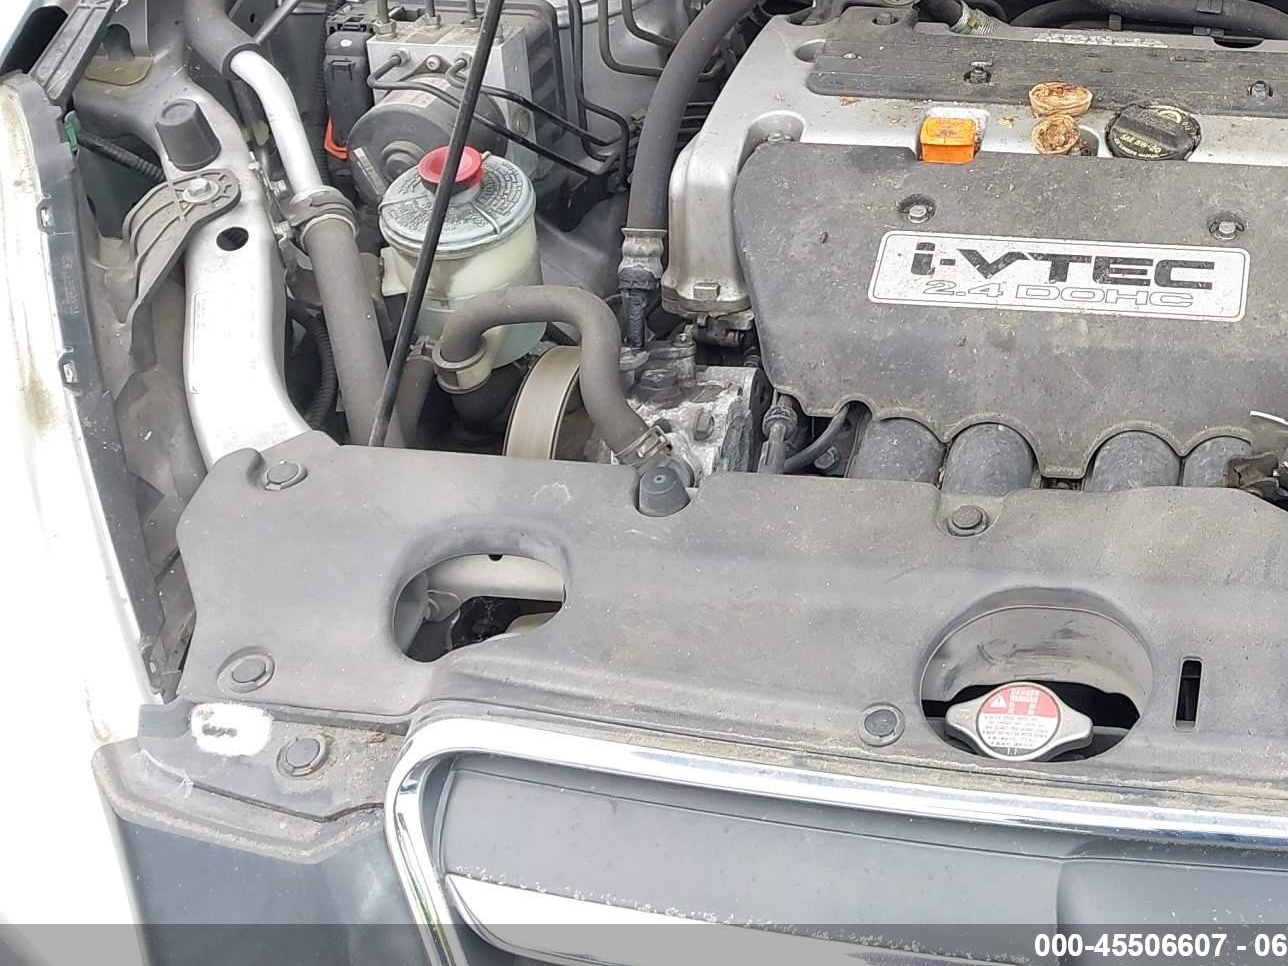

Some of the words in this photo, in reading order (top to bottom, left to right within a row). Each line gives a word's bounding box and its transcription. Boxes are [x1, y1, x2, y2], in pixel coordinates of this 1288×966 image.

[1119, 133, 1135, 144] SAE
[911, 241, 1215, 290] i-VTEC
[923, 279, 1003, 300] 2.4
[1015, 283, 1194, 308] DOHC
